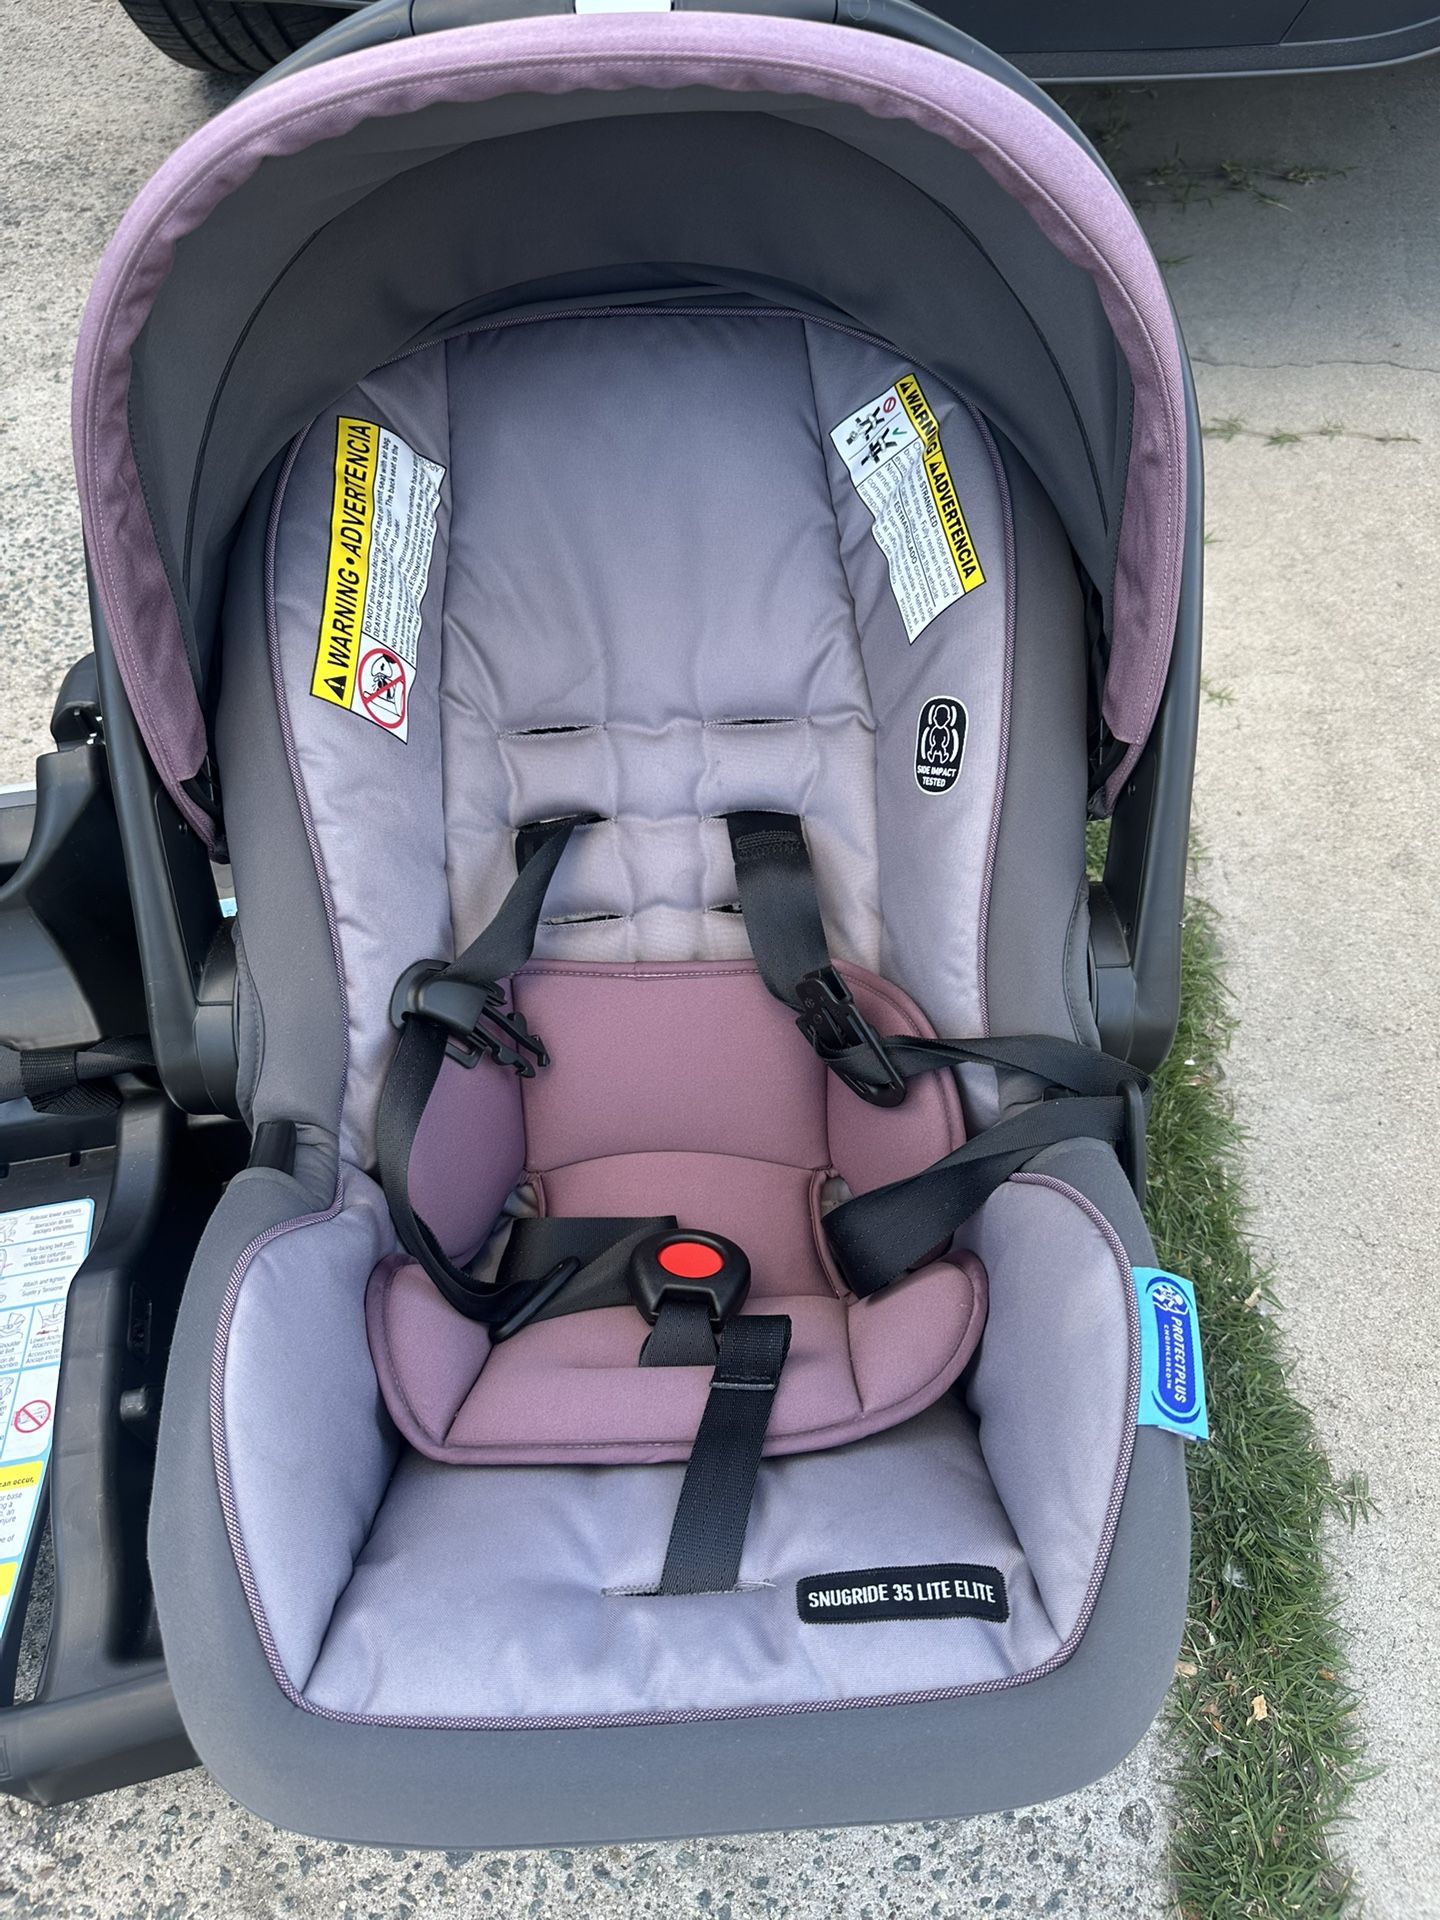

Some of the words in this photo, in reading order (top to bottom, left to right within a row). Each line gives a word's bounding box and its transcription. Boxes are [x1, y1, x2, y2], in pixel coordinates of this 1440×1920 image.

[389, 461, 397, 478] seat
[339, 422, 370, 557] ADVERTENCIA
[387, 477, 395, 494] back
[385, 493, 393, 507] The
[918, 479, 938, 529] STRANGLED
[375, 512, 383, 529] seat
[932, 469, 977, 580] ADVERTENCIA
[932, 527, 940, 536] in
[382, 527, 391, 541] can
[892, 499, 918, 565] ESTRANGULADO
[388, 537, 397, 553] and
[924, 537, 940, 567] restrain
[934, 534, 947, 557] loose
[371, 545, 381, 584] rear-facing
[407, 555, 422, 589] LESIONES
[934, 564, 943, 579] the
[942, 556, 949, 566] or
[377, 566, 387, 600] SERIOUS
[938, 577, 950, 599] child
[944, 564, 960, 596] partially
[368, 583, 376, 604] place
[376, 598, 383, 610] OR
[327, 567, 358, 670] WARNING
[384, 600, 392, 621] place
[364, 620, 371, 633] DO
[373, 611, 381, 637] DEATH
[381, 620, 389, 642] safest
[917, 765, 931, 775] SIDE
[931, 767, 957, 777] IMPACT
[922, 776, 946, 788] TESTED
[1171, 1316, 1187, 1403] PROTECTPLUS
[808, 1584, 889, 1608] SNUGRIDE
[893, 1584, 914, 1602] 35
[917, 1580, 951, 1601] LITE
[954, 1579, 996, 1603] ELITE
